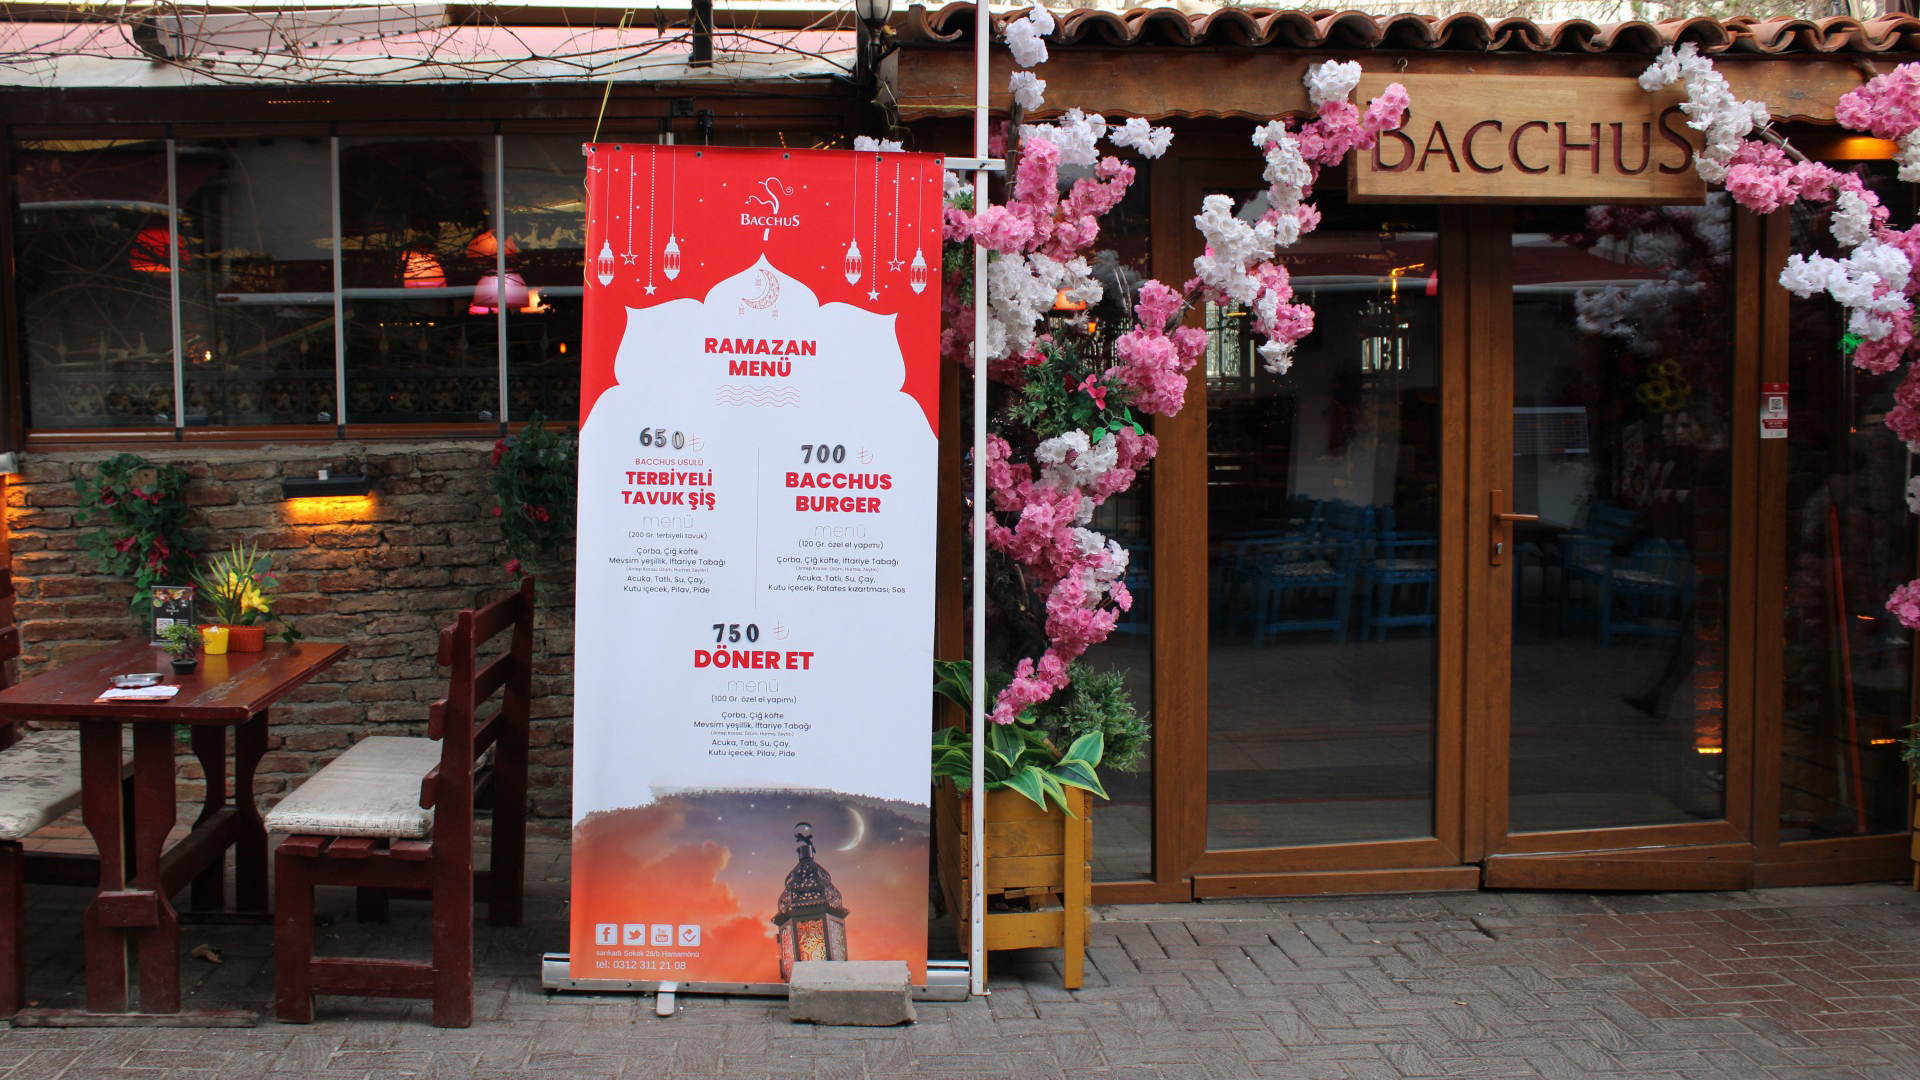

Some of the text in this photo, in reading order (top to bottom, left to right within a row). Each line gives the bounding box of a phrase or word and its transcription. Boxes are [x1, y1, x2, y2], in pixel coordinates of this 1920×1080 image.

[1365, 100, 1694, 176] BACCHUS
[740, 213, 800, 227] BACCHUS
[705, 338, 816, 356] RAMAZAN
[729, 357, 791, 377] MENÜ
[640, 427, 684, 449] 650
[801, 444, 846, 463] 700
[678, 458, 703, 466] USULÜ
[626, 469, 712, 486] TERBİYELİ
[786, 472, 892, 489] BACCHUS
[622, 489, 715, 510] TAVUK ŞİŞ
[796, 496, 881, 513] BURGER
[643, 515, 693, 528] menü
[629, 531, 644, 539] (200
[657, 532, 683, 540] terbiyeli
[815, 524, 866, 538] menü
[854, 542, 883, 550] yapımı)
[637, 548, 662, 556] Çorba,
[664, 548, 677, 556] Çiğ
[641, 558, 668, 566] yeşillik,
[669, 558, 696, 566] İftariye
[699, 558, 725, 567] Tabağı
[777, 556, 899, 567] Çorba, Çiğ köfte, İftariye Tabağı
[688, 577, 705, 585] Çay,
[797, 574, 823, 582] Acuka,
[845, 575, 856, 583] Su,
[859, 575, 876, 584] Çay,
[643, 586, 669, 594] içecek,
[788, 584, 814, 592] içecek,
[848, 585, 890, 593] kızartması,
[713, 624, 760, 642] 750
[694, 645, 814, 670] DÖNER ET
[728, 679, 778, 692] menü
[711, 694, 727, 703] (100
[767, 696, 796, 704] yapımı)
[750, 712, 762, 720] Çiğ
[726, 722, 753, 730] yeşillik,
[755, 722, 782, 730] İftariye
[784, 723, 811, 731] Tabağı
[773, 741, 791, 749] Çay,
[728, 750, 755, 758] içecek,
[596, 960, 686, 970] tel: 0312 311 21 08
